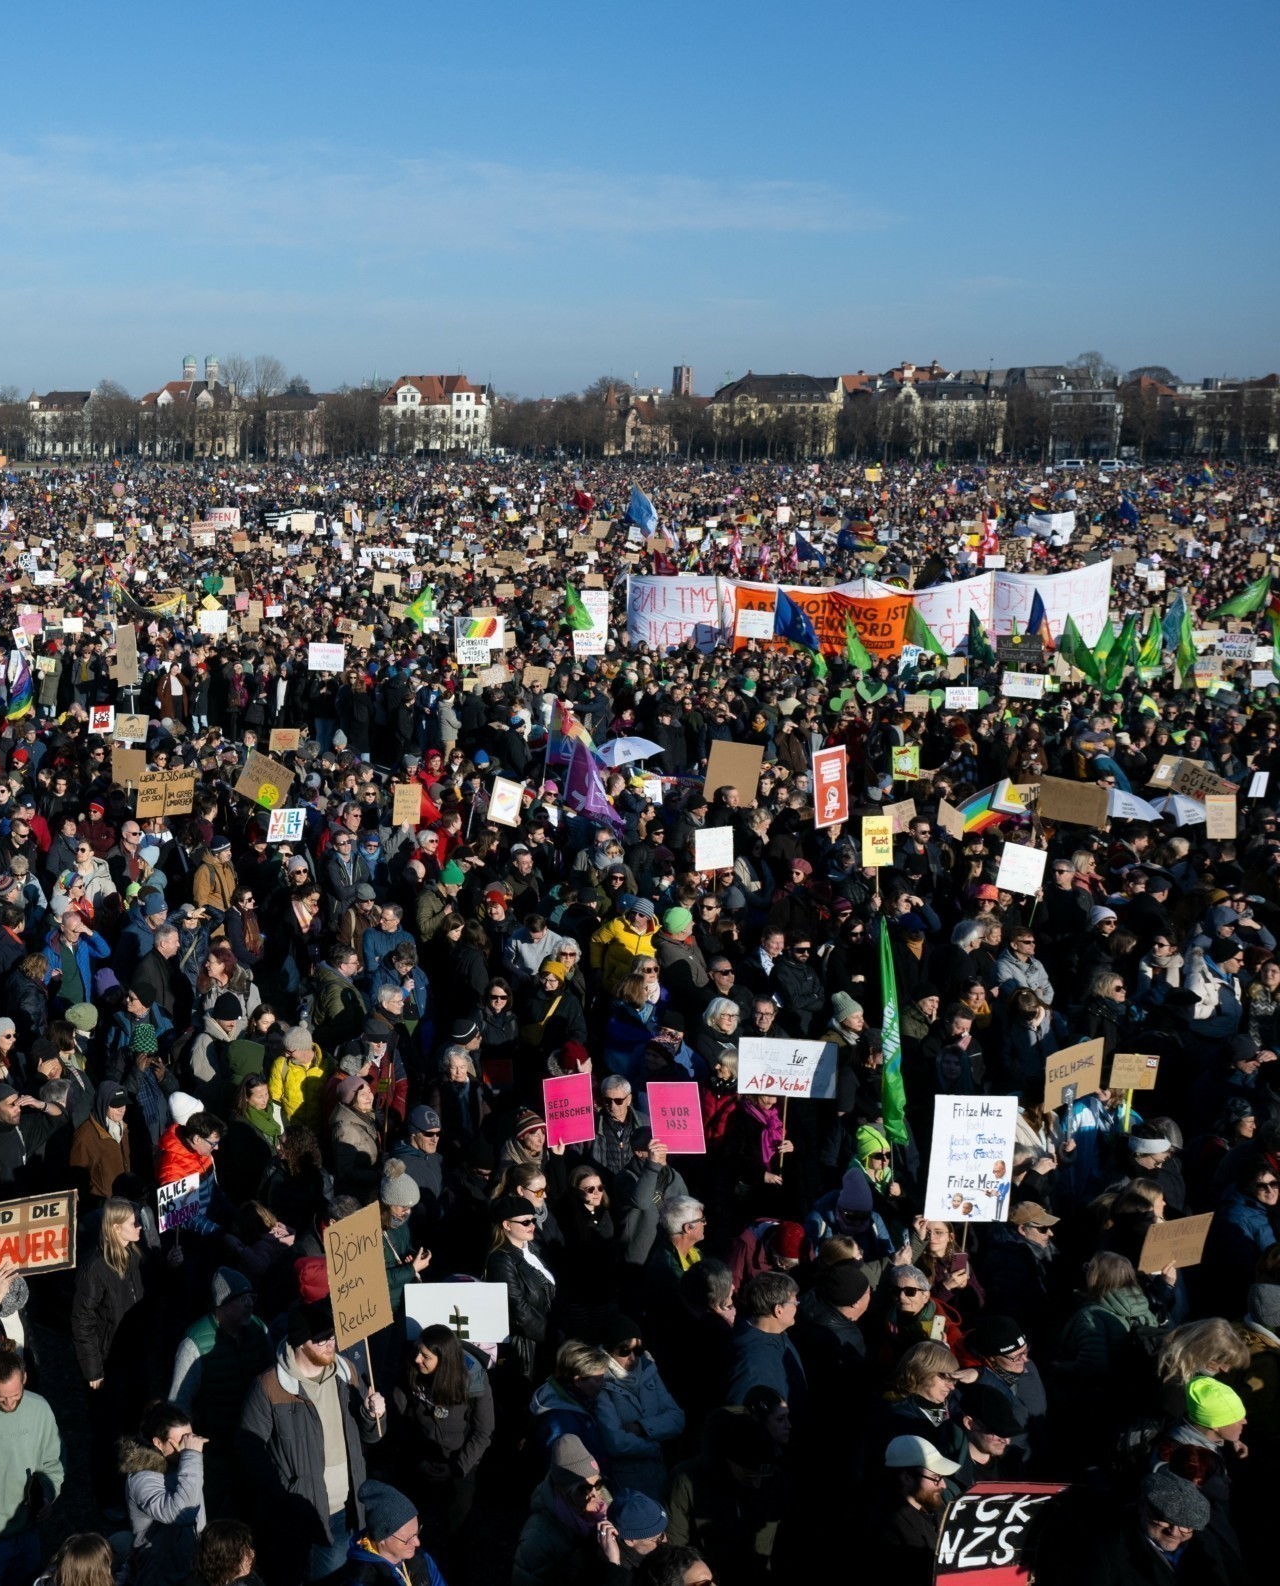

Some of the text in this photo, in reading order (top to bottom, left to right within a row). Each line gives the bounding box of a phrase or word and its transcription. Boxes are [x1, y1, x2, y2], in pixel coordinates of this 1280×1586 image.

[1000, 541, 1024, 550] FCK
[365, 551, 411, 559] KEIN PLATZ
[885, 604, 908, 621] IST
[1224, 650, 1253, 659] NAZIS
[157, 770, 179, 783] JESUS
[176, 789, 193, 799] GRAB
[273, 810, 302, 824] VIEL
[269, 823, 302, 836] FALT
[745, 1073, 811, 1093] AfD-Verbot
[548, 1098, 570, 1111] SEID
[661, 1106, 691, 1117] 5 VOR
[952, 1102, 1003, 1119] Fritze Merz
[548, 1106, 591, 1121] MENSCHEN
[665, 1118, 688, 1130] 1933
[947, 1173, 1000, 1190] Fritze Merz
[159, 1178, 187, 1204] ALICE
[31, 1201, 61, 1219] DIE
[159, 1200, 176, 1218] INS
[336, 1276, 365, 1303] gegen
[338, 1303, 377, 1336] Rechts
[948, 1494, 1052, 1524] FCK
[937, 1525, 1024, 1568] NZS
